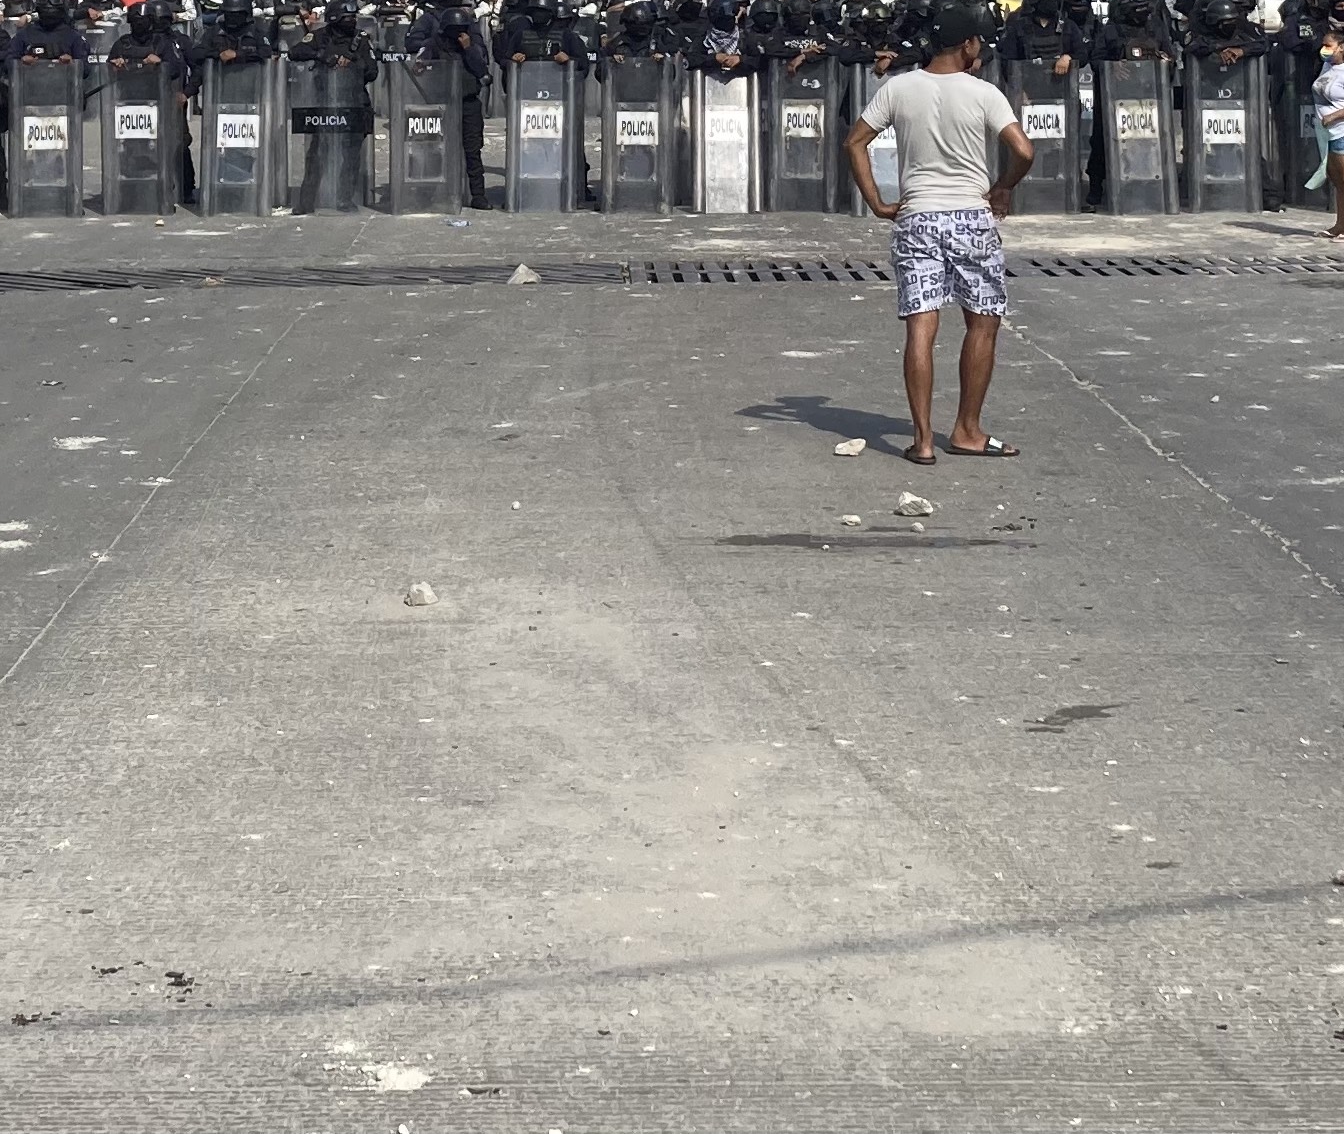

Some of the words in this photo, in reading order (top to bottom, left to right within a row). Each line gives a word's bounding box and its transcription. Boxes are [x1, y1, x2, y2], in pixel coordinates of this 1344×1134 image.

[120, 113, 152, 130] POLICIA
[305, 116, 347, 126] POLICIA
[409, 117, 441, 134] POLICIA
[526, 114, 556, 129] POLICIA
[622, 120, 655, 136] POLICIA
[787, 113, 818, 128] POLICIA
[1028, 114, 1059, 129] POLICIA
[1122, 114, 1152, 129] POLICIA
[1207, 119, 1240, 134] POLICIA
[29, 125, 63, 141] POLICIA
[223, 123, 255, 139] POLICIA
